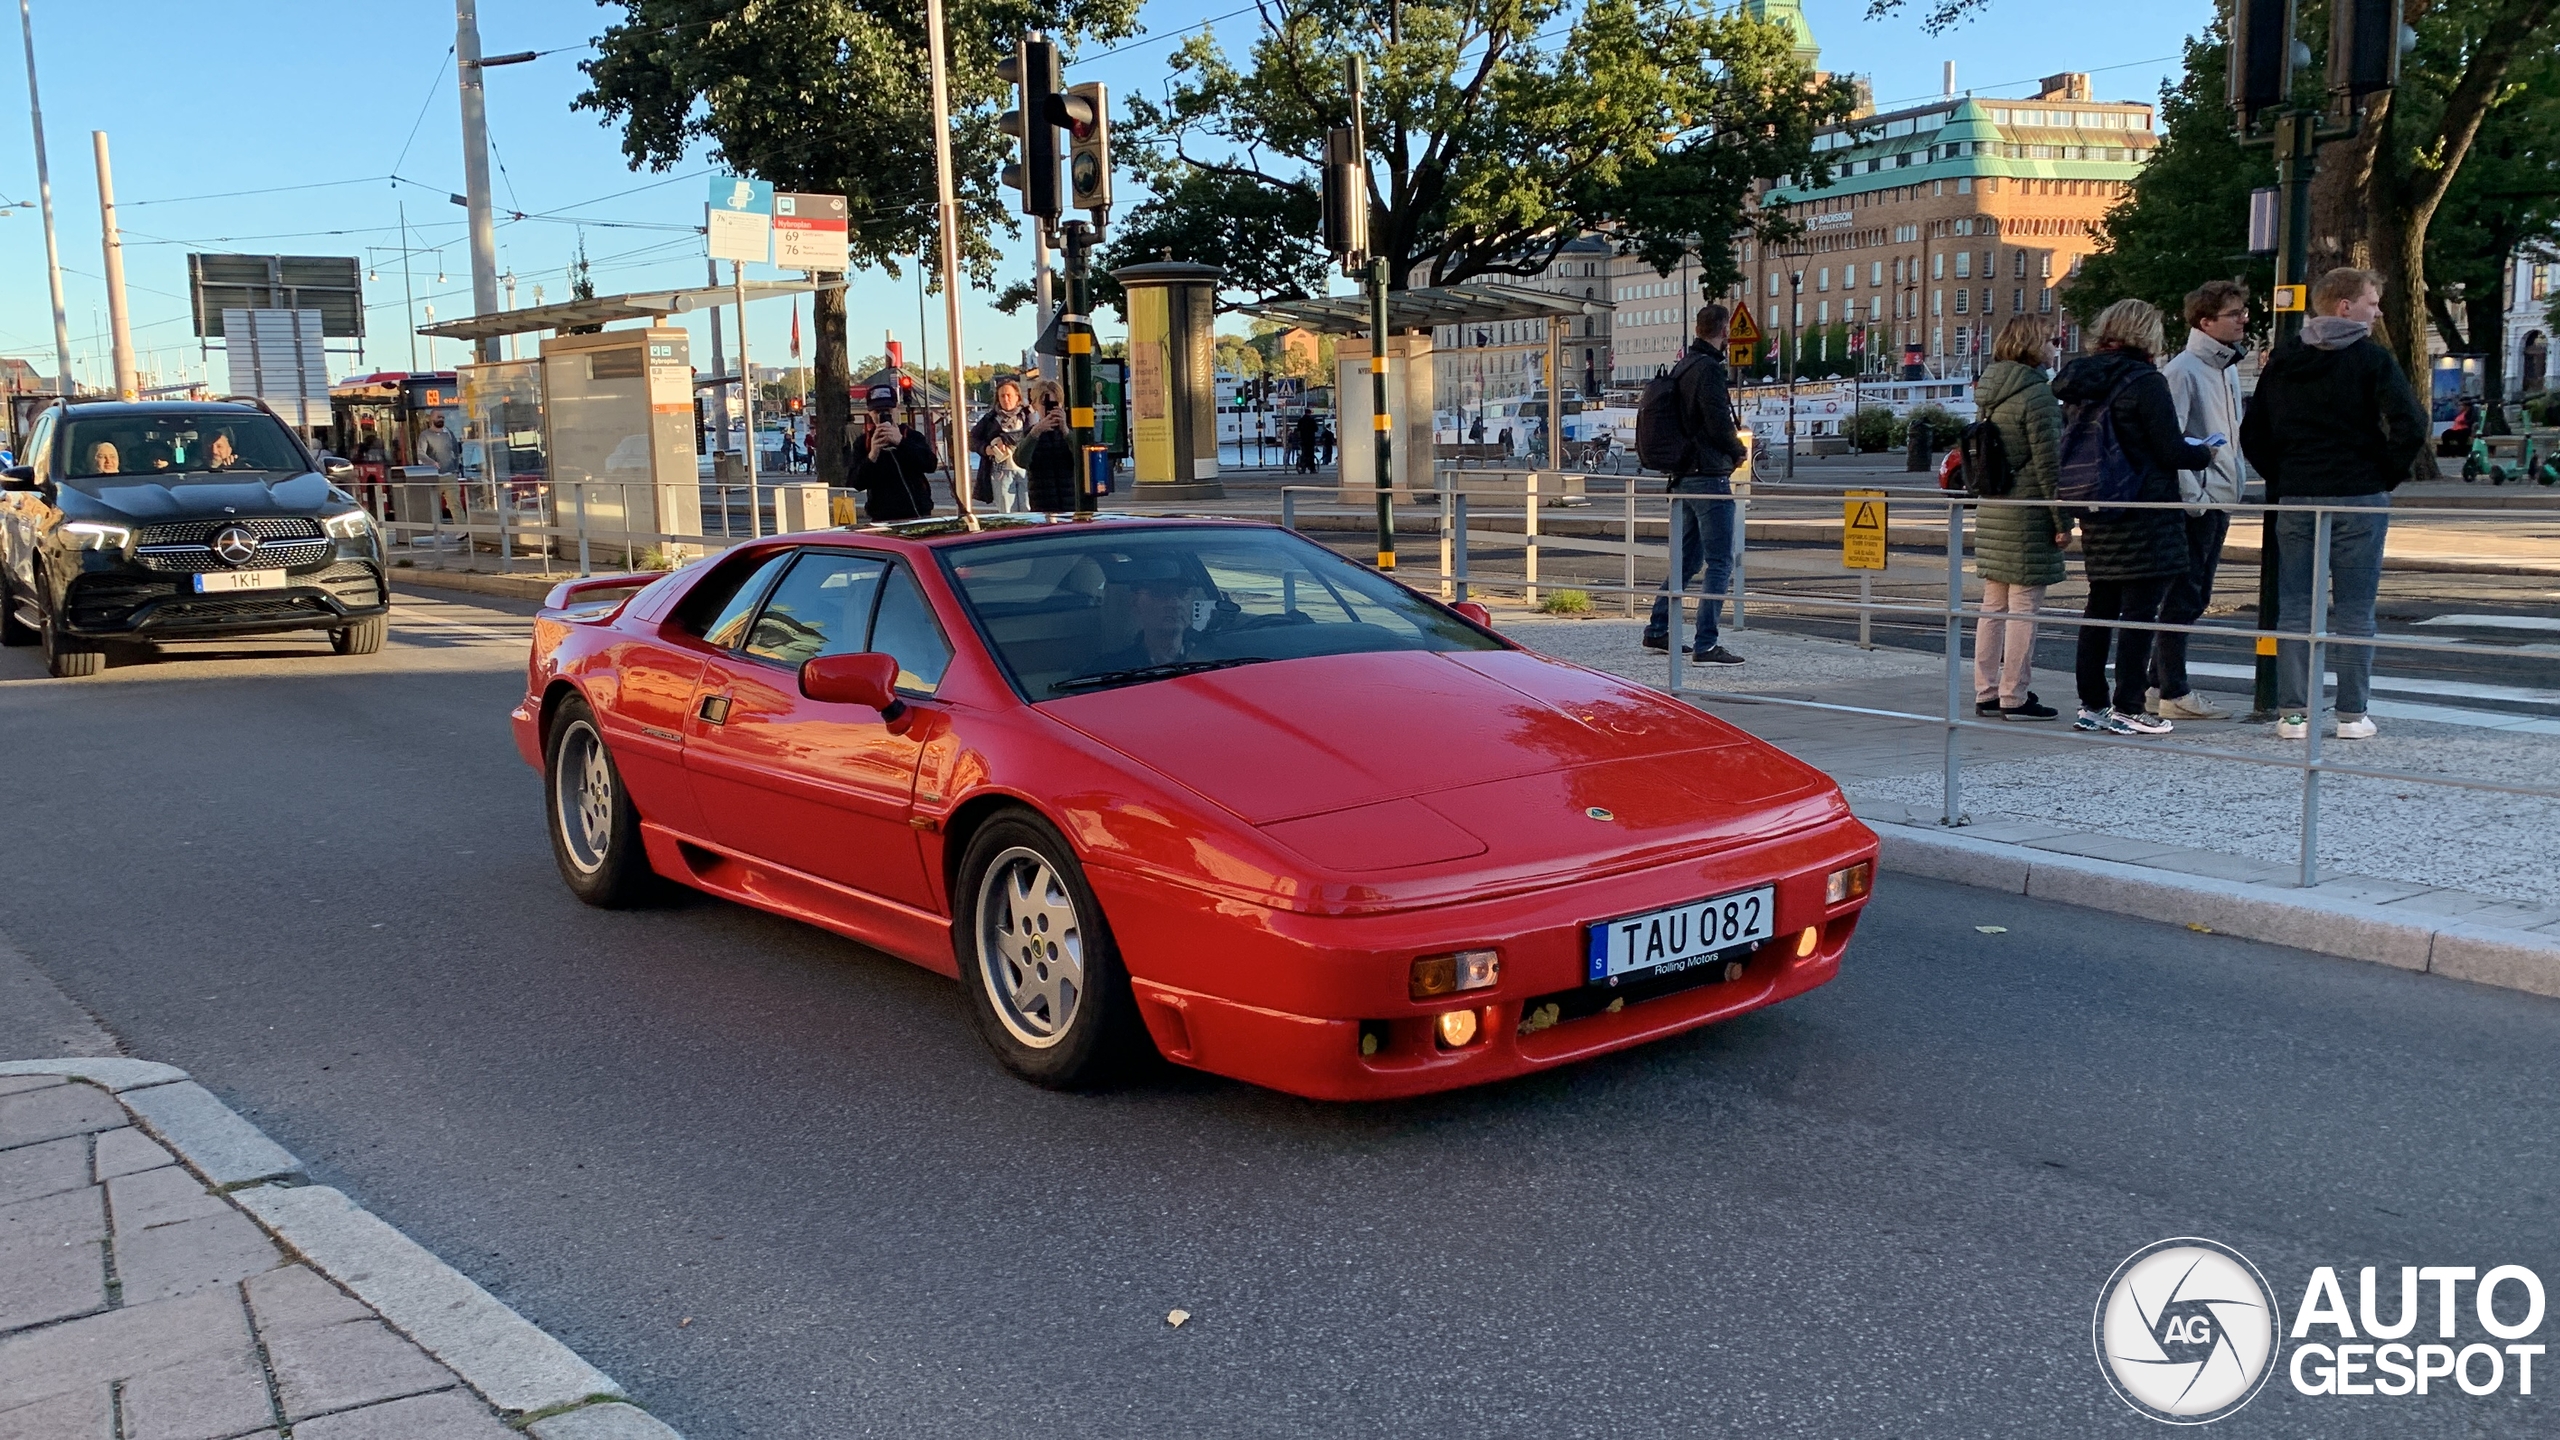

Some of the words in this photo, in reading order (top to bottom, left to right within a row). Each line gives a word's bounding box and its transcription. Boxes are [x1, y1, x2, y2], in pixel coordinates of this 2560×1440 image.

[1819, 212, 1853, 224] RADISSON
[777, 219, 812, 229] Nybroplan
[1819, 222, 1853, 230] COLLECTION
[785, 231, 799, 242] 69
[785, 245, 799, 255] 76
[230, 573, 261, 588] 1KH
[1595, 958, 1602, 970] S
[1622, 912, 1688, 965] TAU
[1700, 896, 1761, 946] 082
[1654, 959, 1686, 976] Rolling
[1687, 952, 1719, 969] Motors
